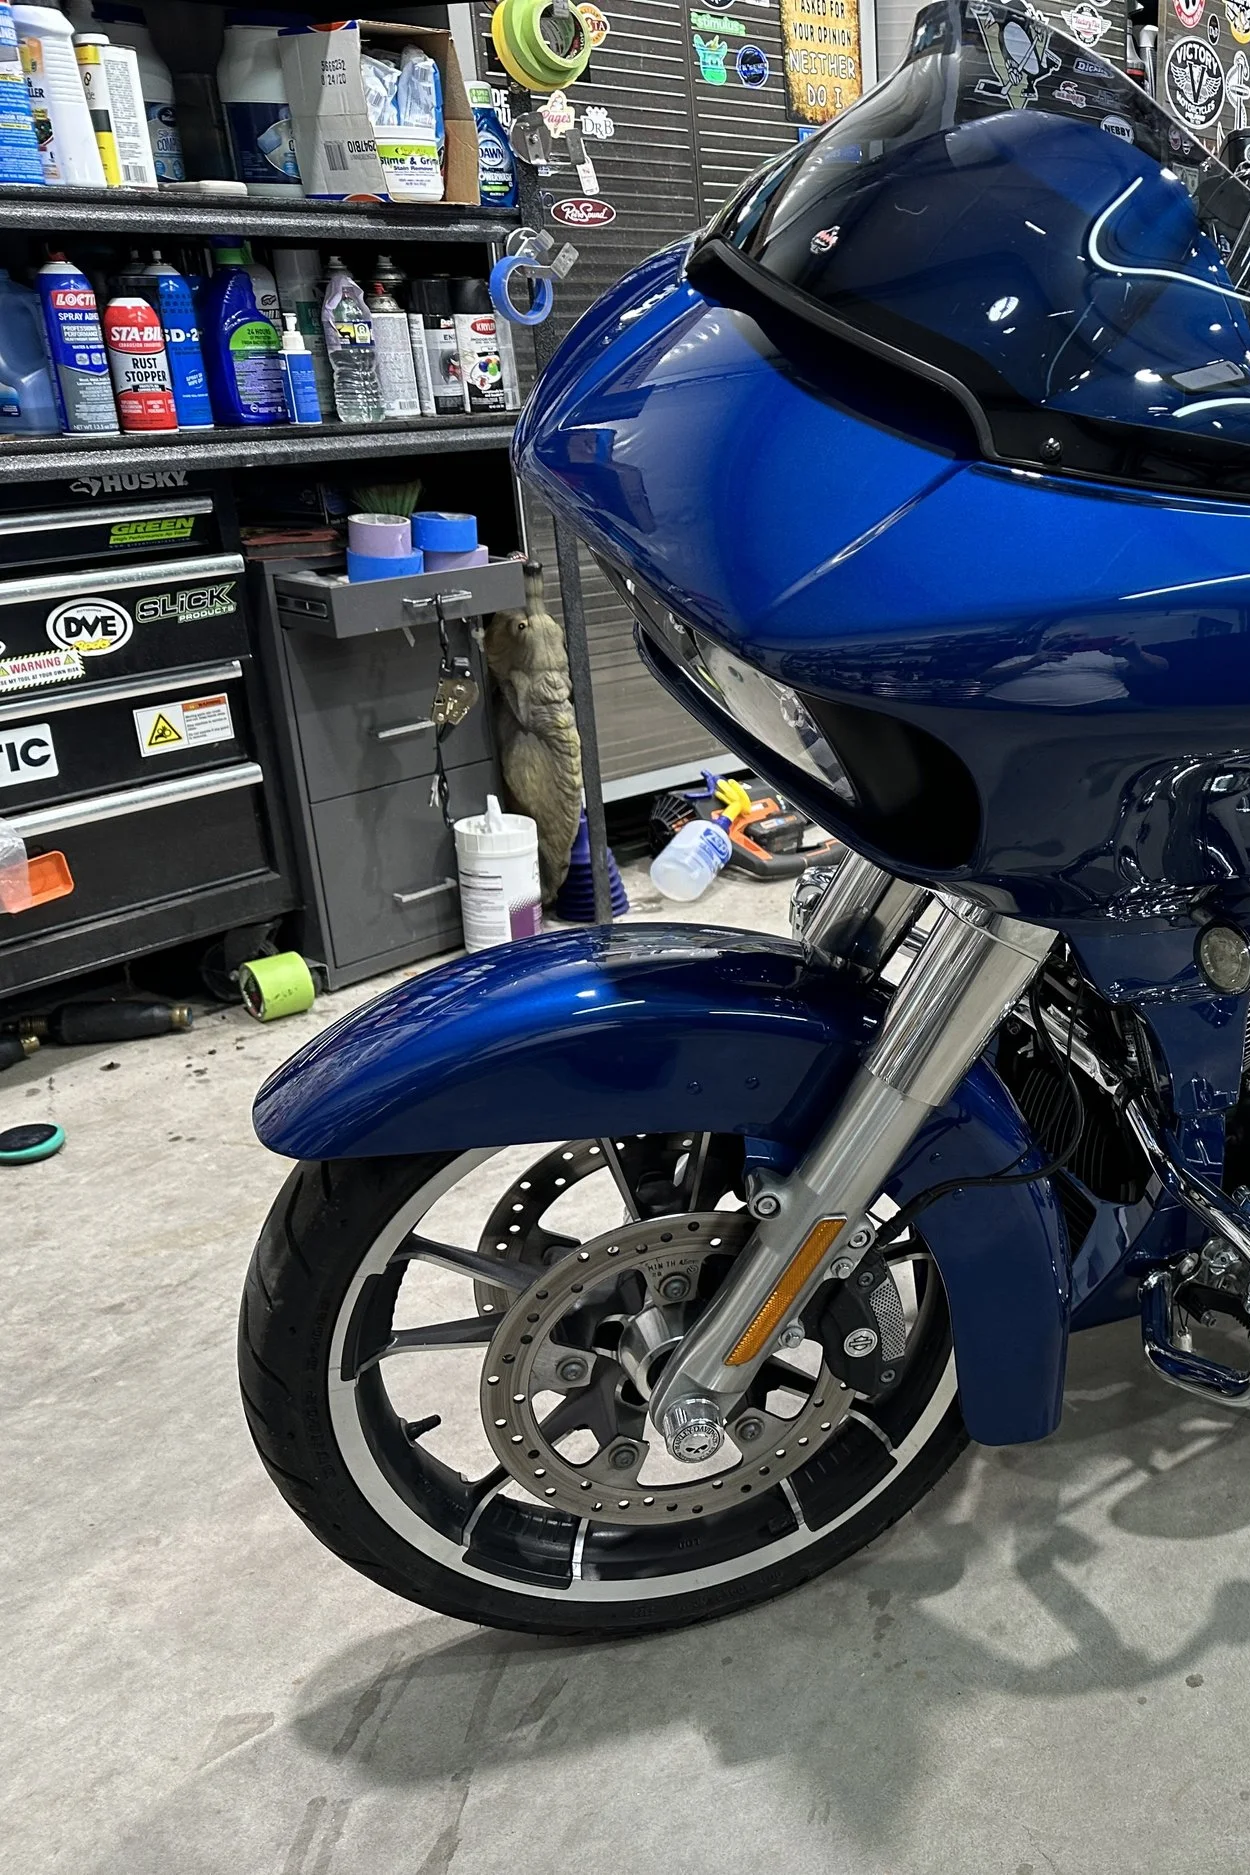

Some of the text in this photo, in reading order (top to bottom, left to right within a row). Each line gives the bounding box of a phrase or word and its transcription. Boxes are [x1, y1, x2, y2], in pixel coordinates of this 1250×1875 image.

[801, 0, 827, 18] ASKED
[830, 4, 845, 18] FOR
[793, 22, 851, 46] YOUR OPINION
[788, 48, 856, 80] NEITHER
[1176, 43, 1218, 75] VICTORY
[807, 83, 844, 109] DO I
[1176, 91, 1216, 115] MOTORCYCLES
[1103, 124, 1131, 138] NEBBY
[380, 156, 405, 166] Slime
[409, 156, 417, 165] &
[478, 147, 504, 159] DAWN
[560, 202, 608, 222] RetroSound
[58, 312, 83, 321] SPRAY
[132, 357, 157, 369] RUST
[125, 370, 167, 382] STOPPER
[102, 471, 187, 493] HUSKY
[111, 517, 195, 535] GREEN
[179, 604, 236, 623] PRODUCTS
[64, 615, 118, 638] DVE
[9, 656, 61, 674] WARNING
[54, 668, 67, 676] OWN
[0, 737, 52, 772] IC
